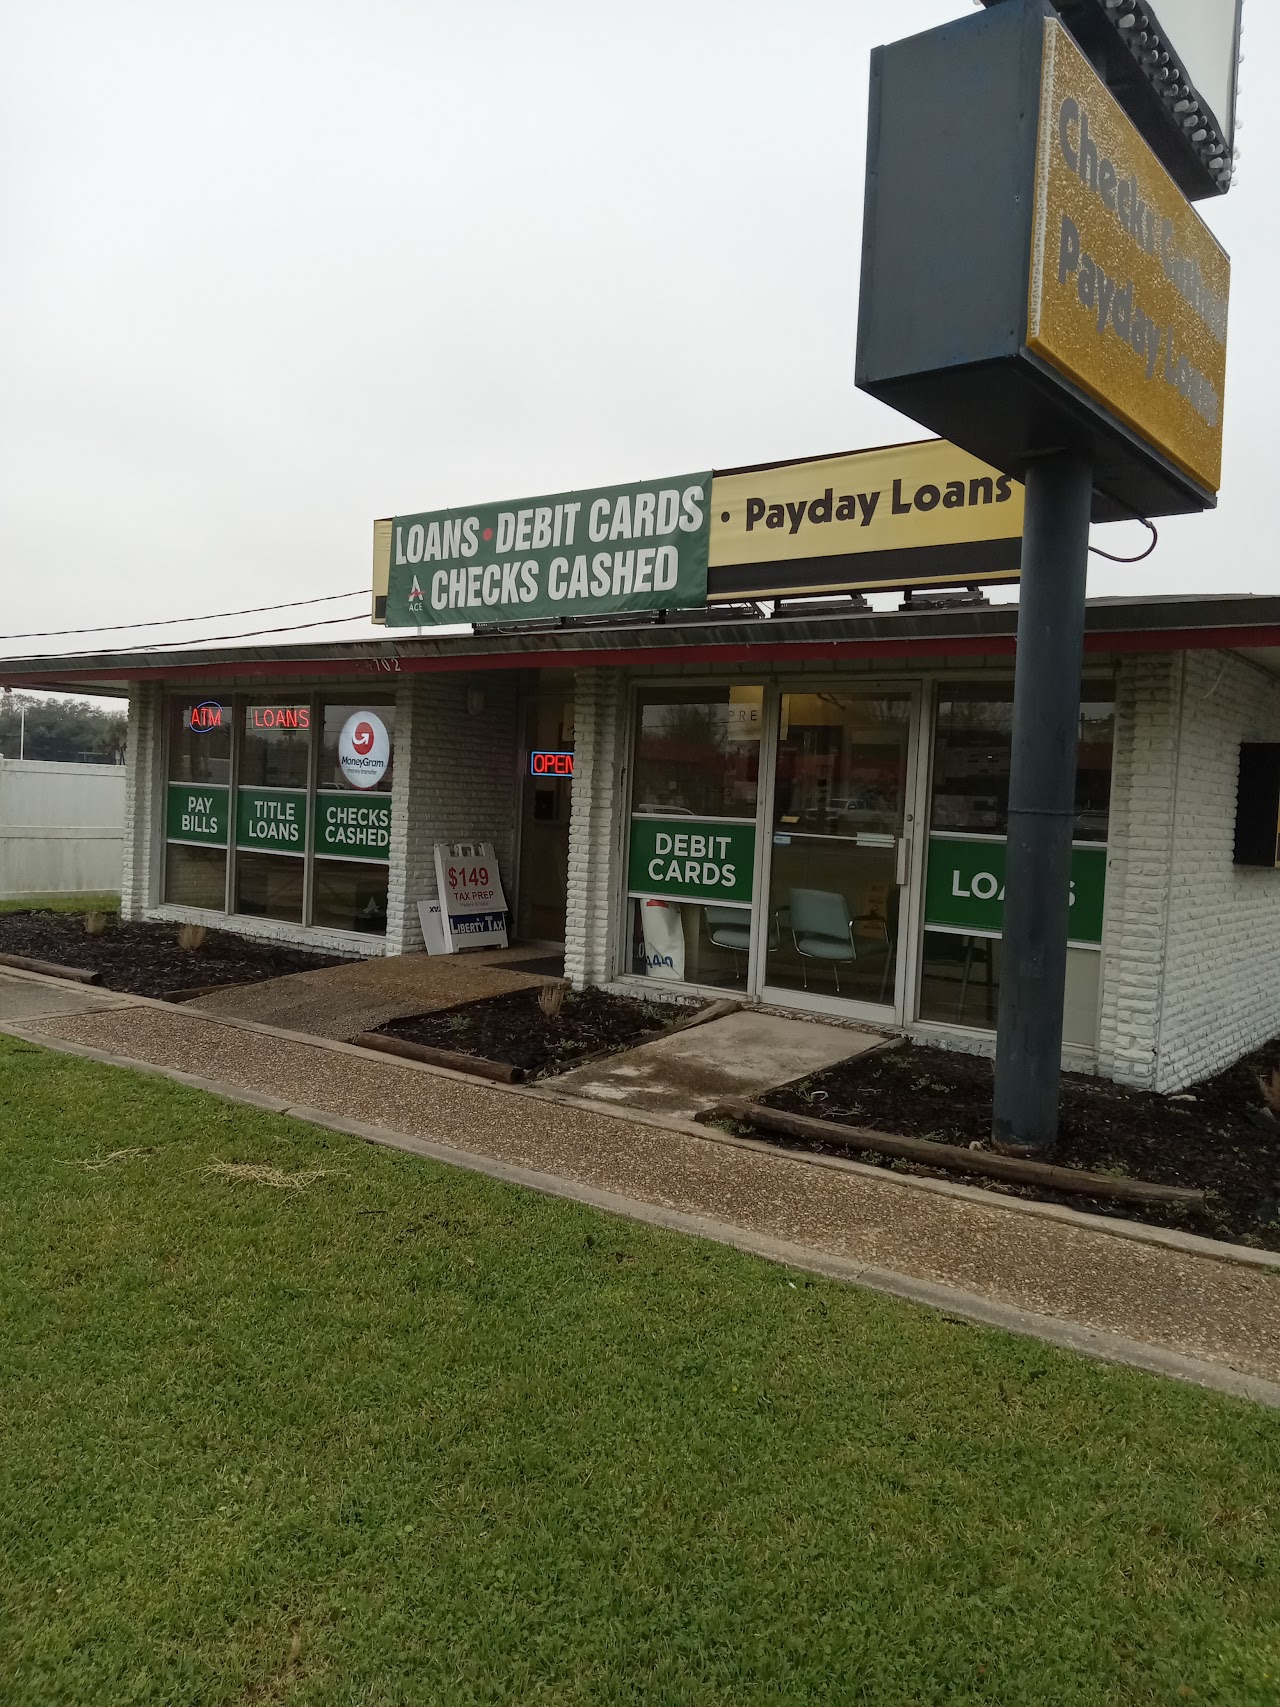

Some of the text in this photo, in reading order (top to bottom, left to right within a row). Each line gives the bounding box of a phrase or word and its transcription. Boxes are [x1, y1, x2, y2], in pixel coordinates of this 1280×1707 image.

[1059, 216, 1160, 380] Payday
[746, 474, 1012, 535] Payday Loans
[395, 485, 705, 566] LOANS DEBIT CARDS
[430, 545, 679, 611] CHECKS CASHED
[408, 602, 423, 612] ACE
[191, 708, 221, 727] ATM
[254, 709, 310, 728] LOANS
[341, 756, 384, 768] MoneyGram
[188, 796, 213, 814] PAY
[254, 800, 295, 821] TITLE
[181, 814, 218, 834] BILLS
[326, 806, 389, 827] CHECKS
[248, 820, 299, 842] LOANS
[325, 826, 388, 847] CASHED
[655, 832, 732, 860] DEBIT
[448, 866, 489, 889] $149
[648, 858, 737, 887] CARDS
[453, 890, 494, 901] TAX PREP
[952, 869, 1076, 907] LOS
[450, 915, 504, 934] LIBERTY TAX
